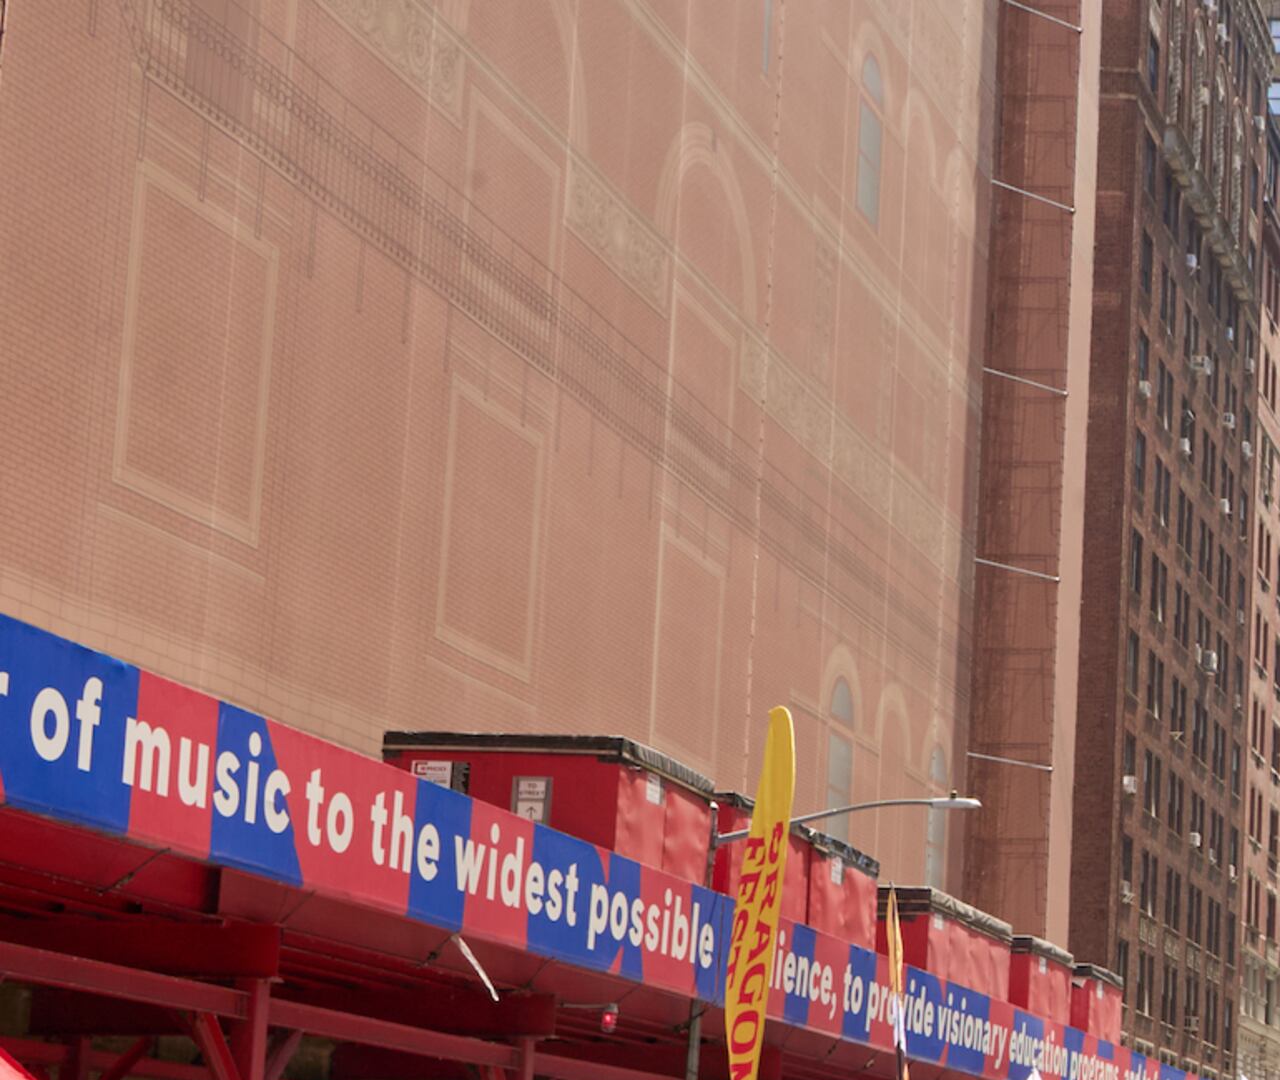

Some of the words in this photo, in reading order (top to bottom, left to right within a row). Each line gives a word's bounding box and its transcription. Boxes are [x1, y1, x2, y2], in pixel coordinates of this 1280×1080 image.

[30, 676, 103, 772] of
[122, 715, 291, 835] music
[305, 768, 355, 854] to
[371, 789, 441, 882] the
[454, 823, 579, 928] widest
[588, 885, 715, 969] possible
[768, 928, 838, 1021] ience,
[843, 963, 863, 1015] to
[865, 979, 933, 1038] provide
[937, 991, 1008, 1070] visionary
[1008, 1021, 1068, 1078] education
